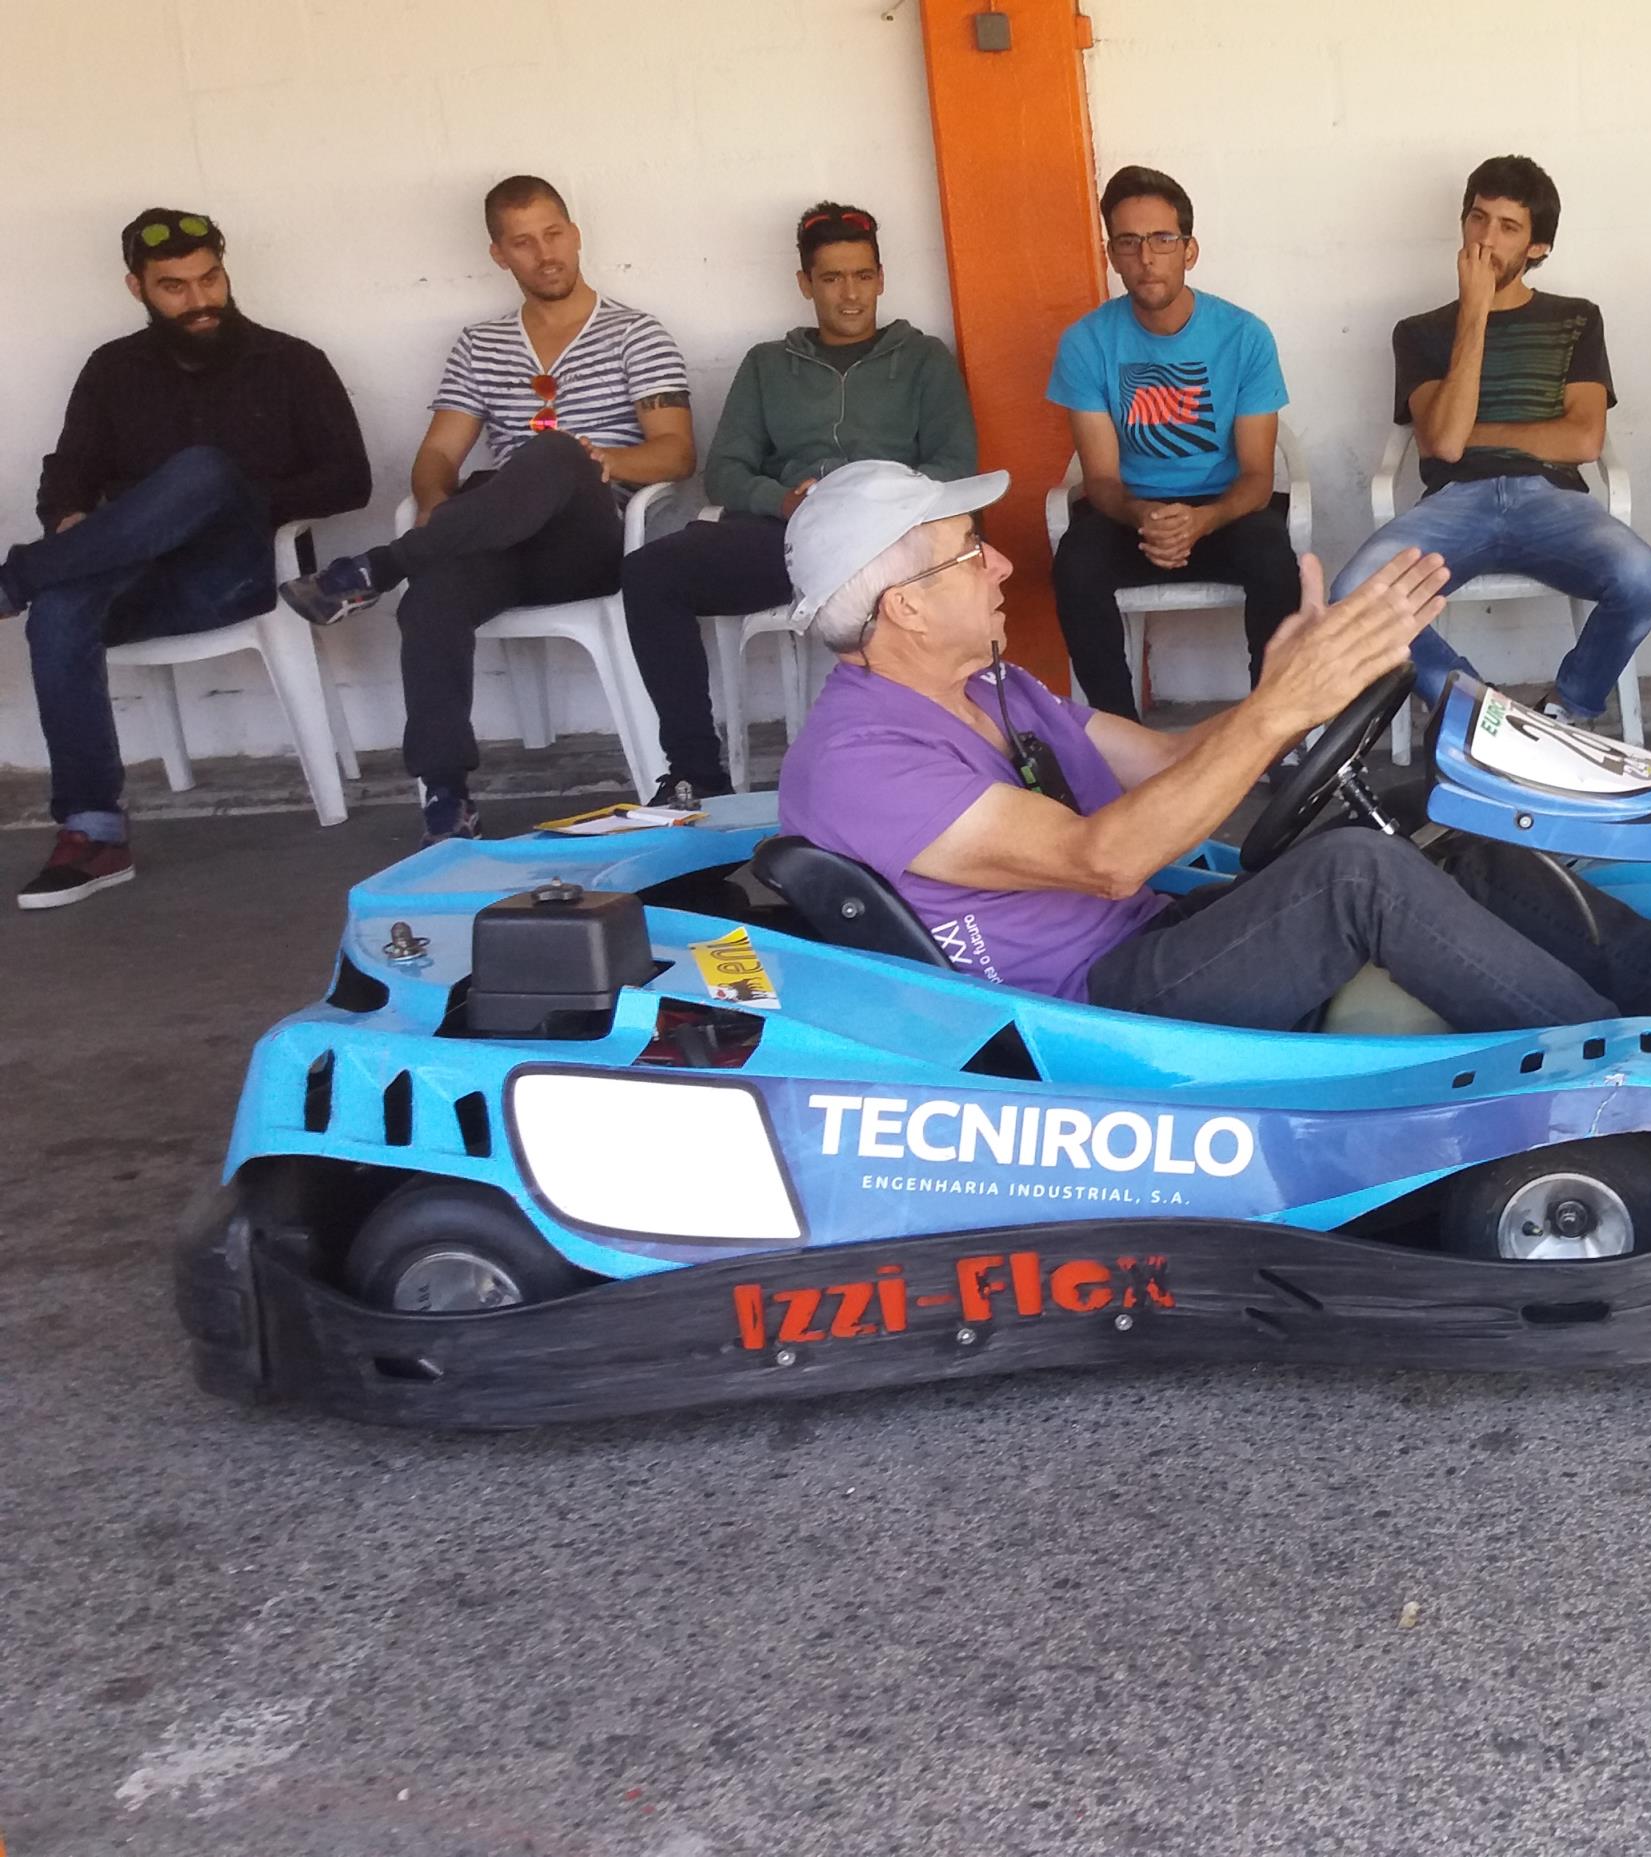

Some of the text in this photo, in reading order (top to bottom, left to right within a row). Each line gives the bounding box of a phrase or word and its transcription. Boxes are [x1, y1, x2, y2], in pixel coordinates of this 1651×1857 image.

[963, 913, 986, 955] futuro
[808, 1094, 1255, 1178] TECNIROLO
[861, 1174, 999, 1196] ENGENHARIA
[1008, 1182, 1142, 1205] INDUSTRIAL,
